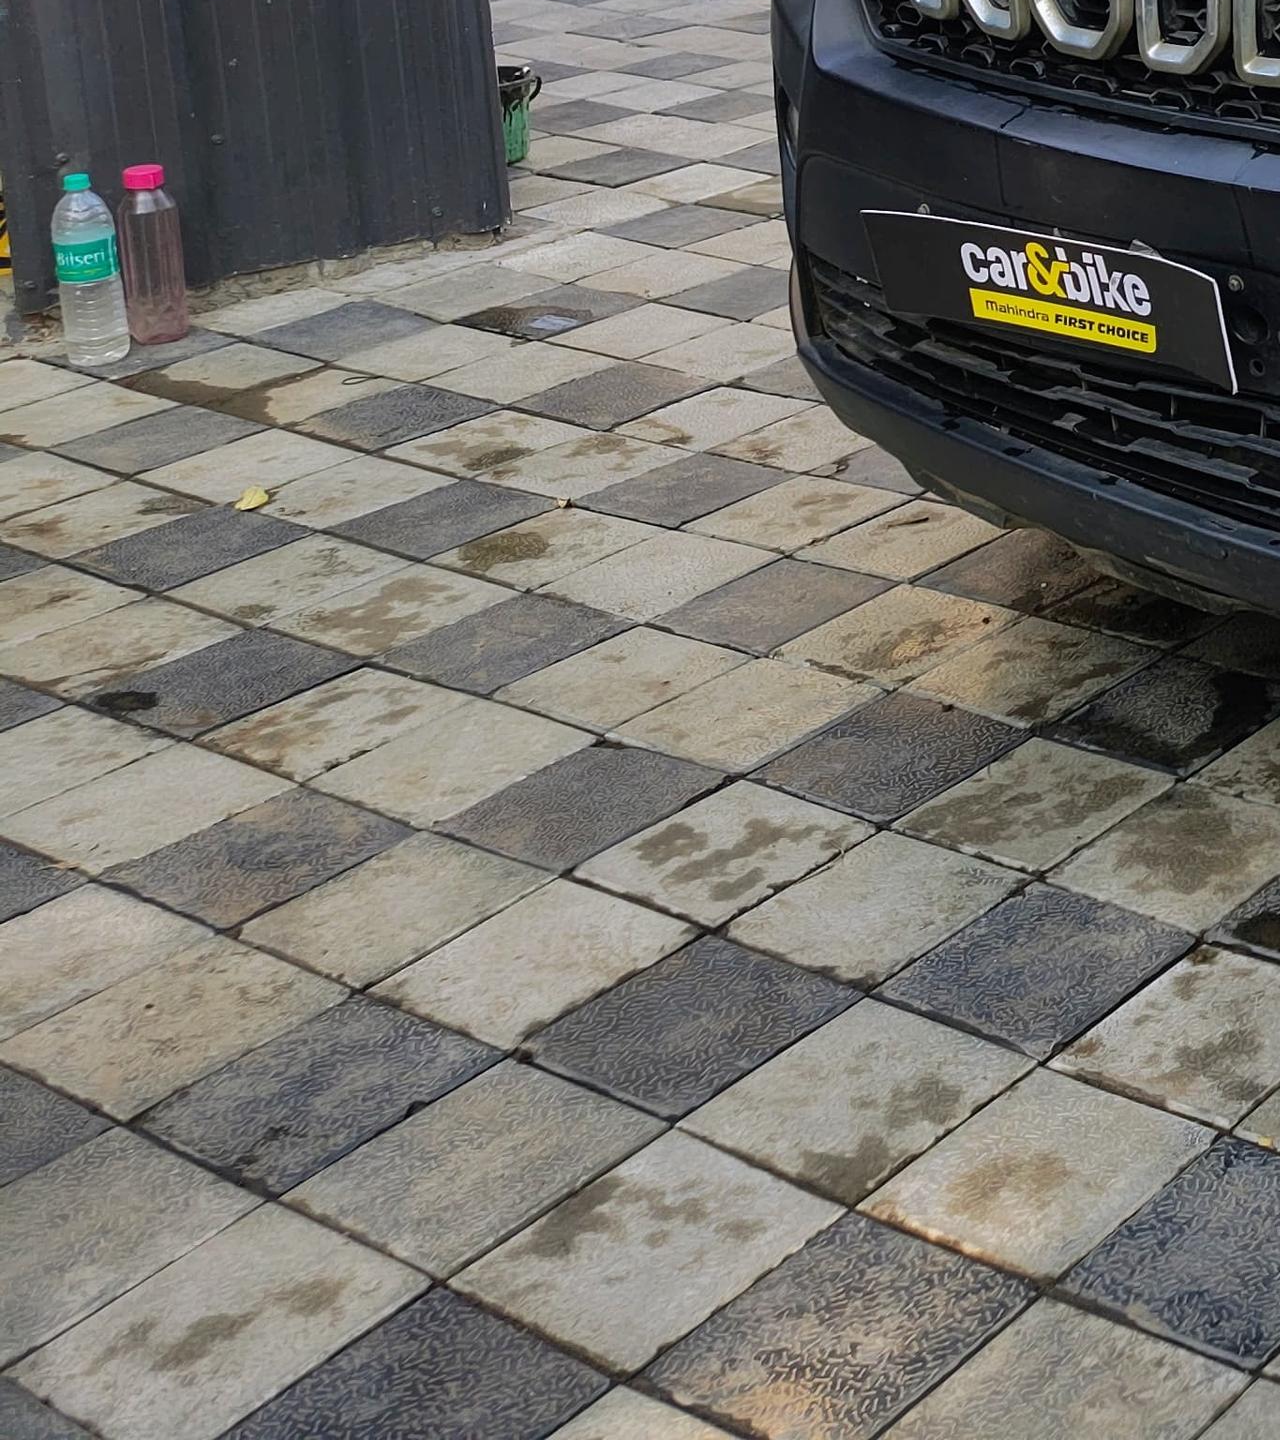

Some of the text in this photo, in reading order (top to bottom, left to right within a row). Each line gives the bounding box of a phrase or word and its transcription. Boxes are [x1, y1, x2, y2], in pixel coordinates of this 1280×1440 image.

[960, 242, 1153, 317] car&bike
[984, 299, 1149, 344] Mahindra FIRST CHOICE
